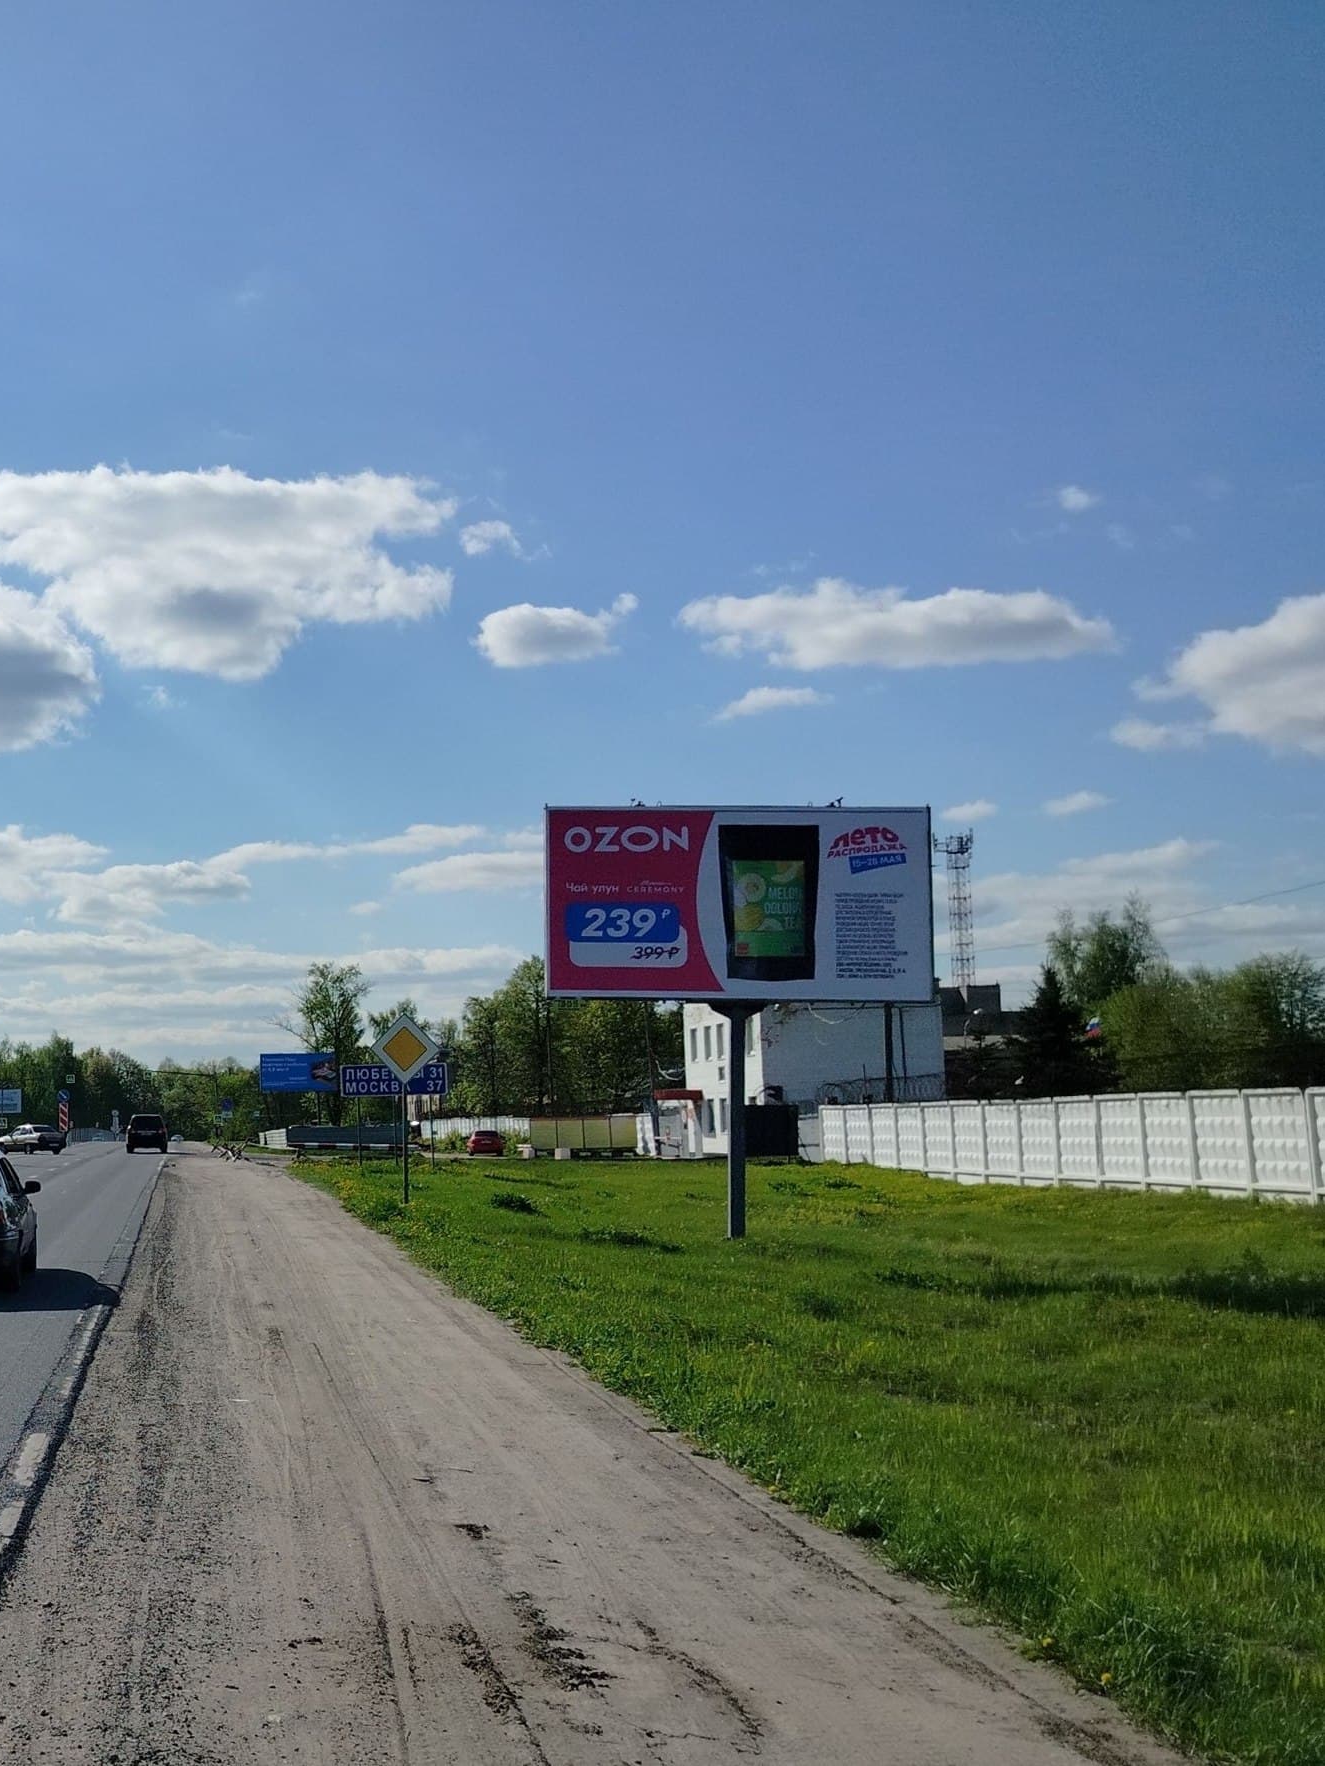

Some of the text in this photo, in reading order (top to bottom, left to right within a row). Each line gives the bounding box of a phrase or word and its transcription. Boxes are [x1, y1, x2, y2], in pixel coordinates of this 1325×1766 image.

[564, 826, 689, 853] OZON
[880, 854, 902, 865] МАЯ
[566, 882, 619, 896] Чай улун
[581, 908, 656, 937] 239
[346, 1067, 443, 1080] ЛЮБЕЫ 31
[426, 1080, 443, 1092] 37
